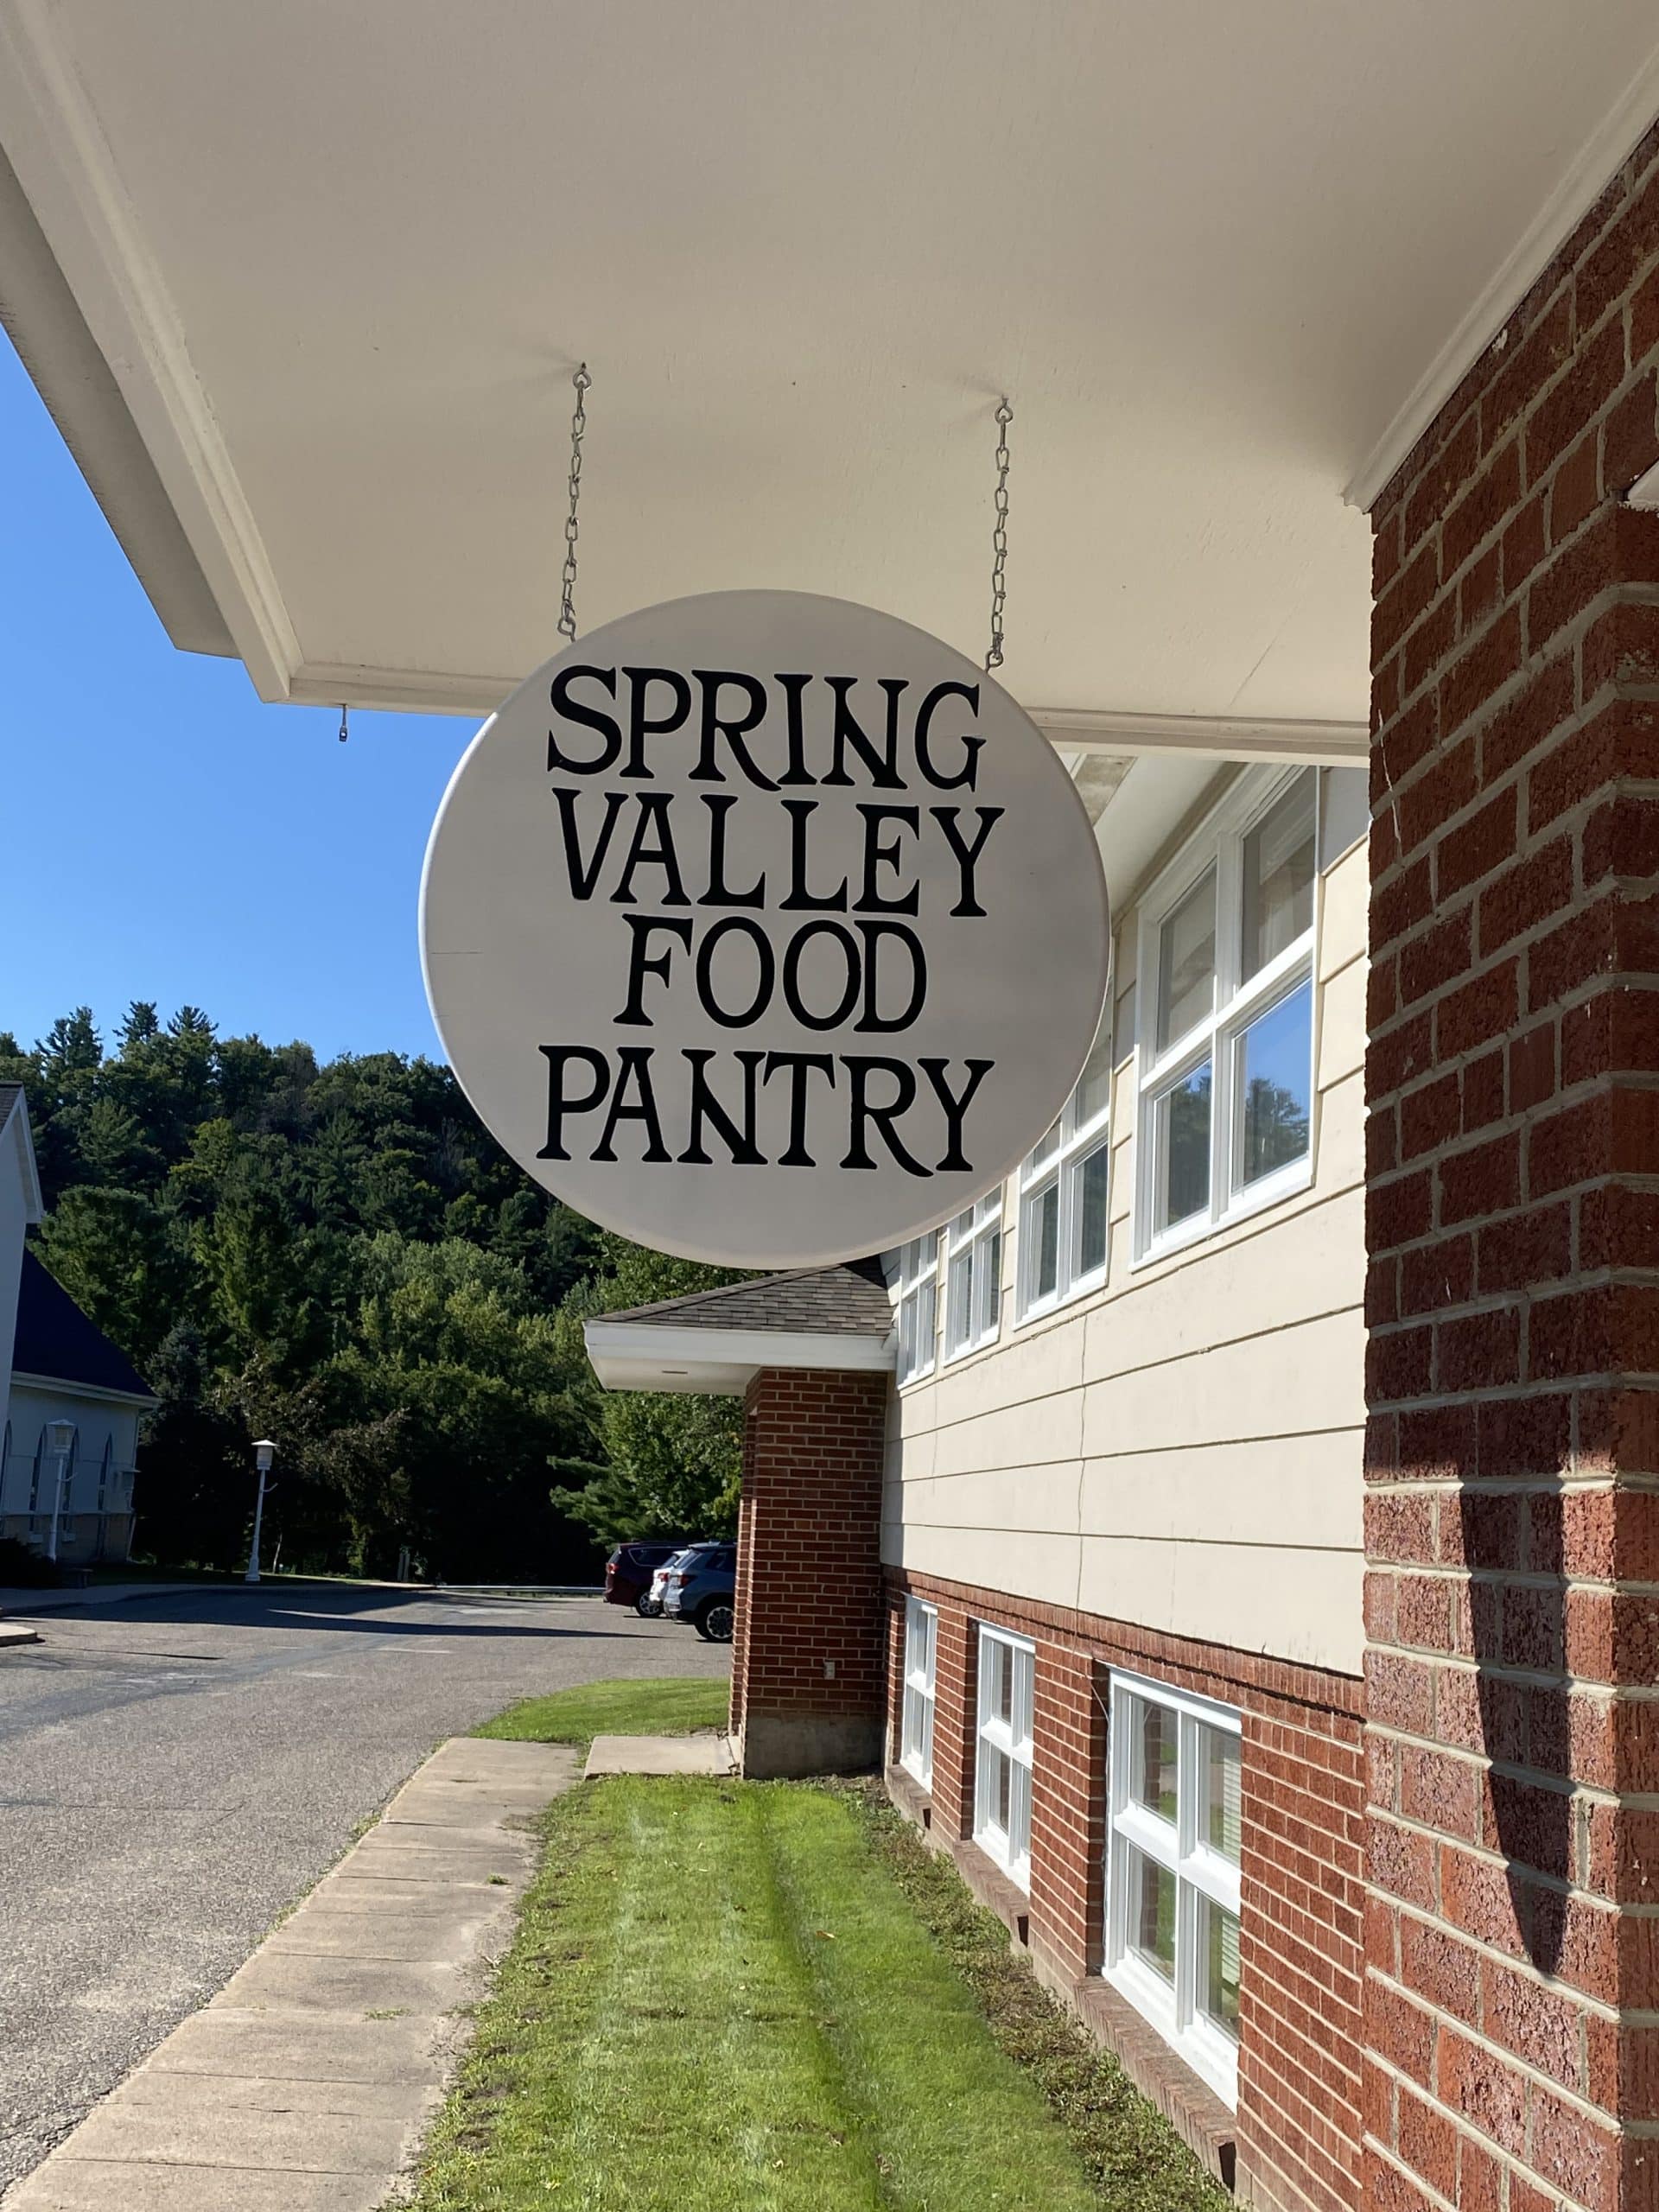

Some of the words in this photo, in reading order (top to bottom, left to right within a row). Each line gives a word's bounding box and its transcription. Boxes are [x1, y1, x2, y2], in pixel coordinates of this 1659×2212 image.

[548, 665, 986, 792] SPRING
[552, 788, 1005, 917] VALLEY
[613, 913, 926, 1033] FOOD
[537, 1046, 995, 1177] PANTRY
